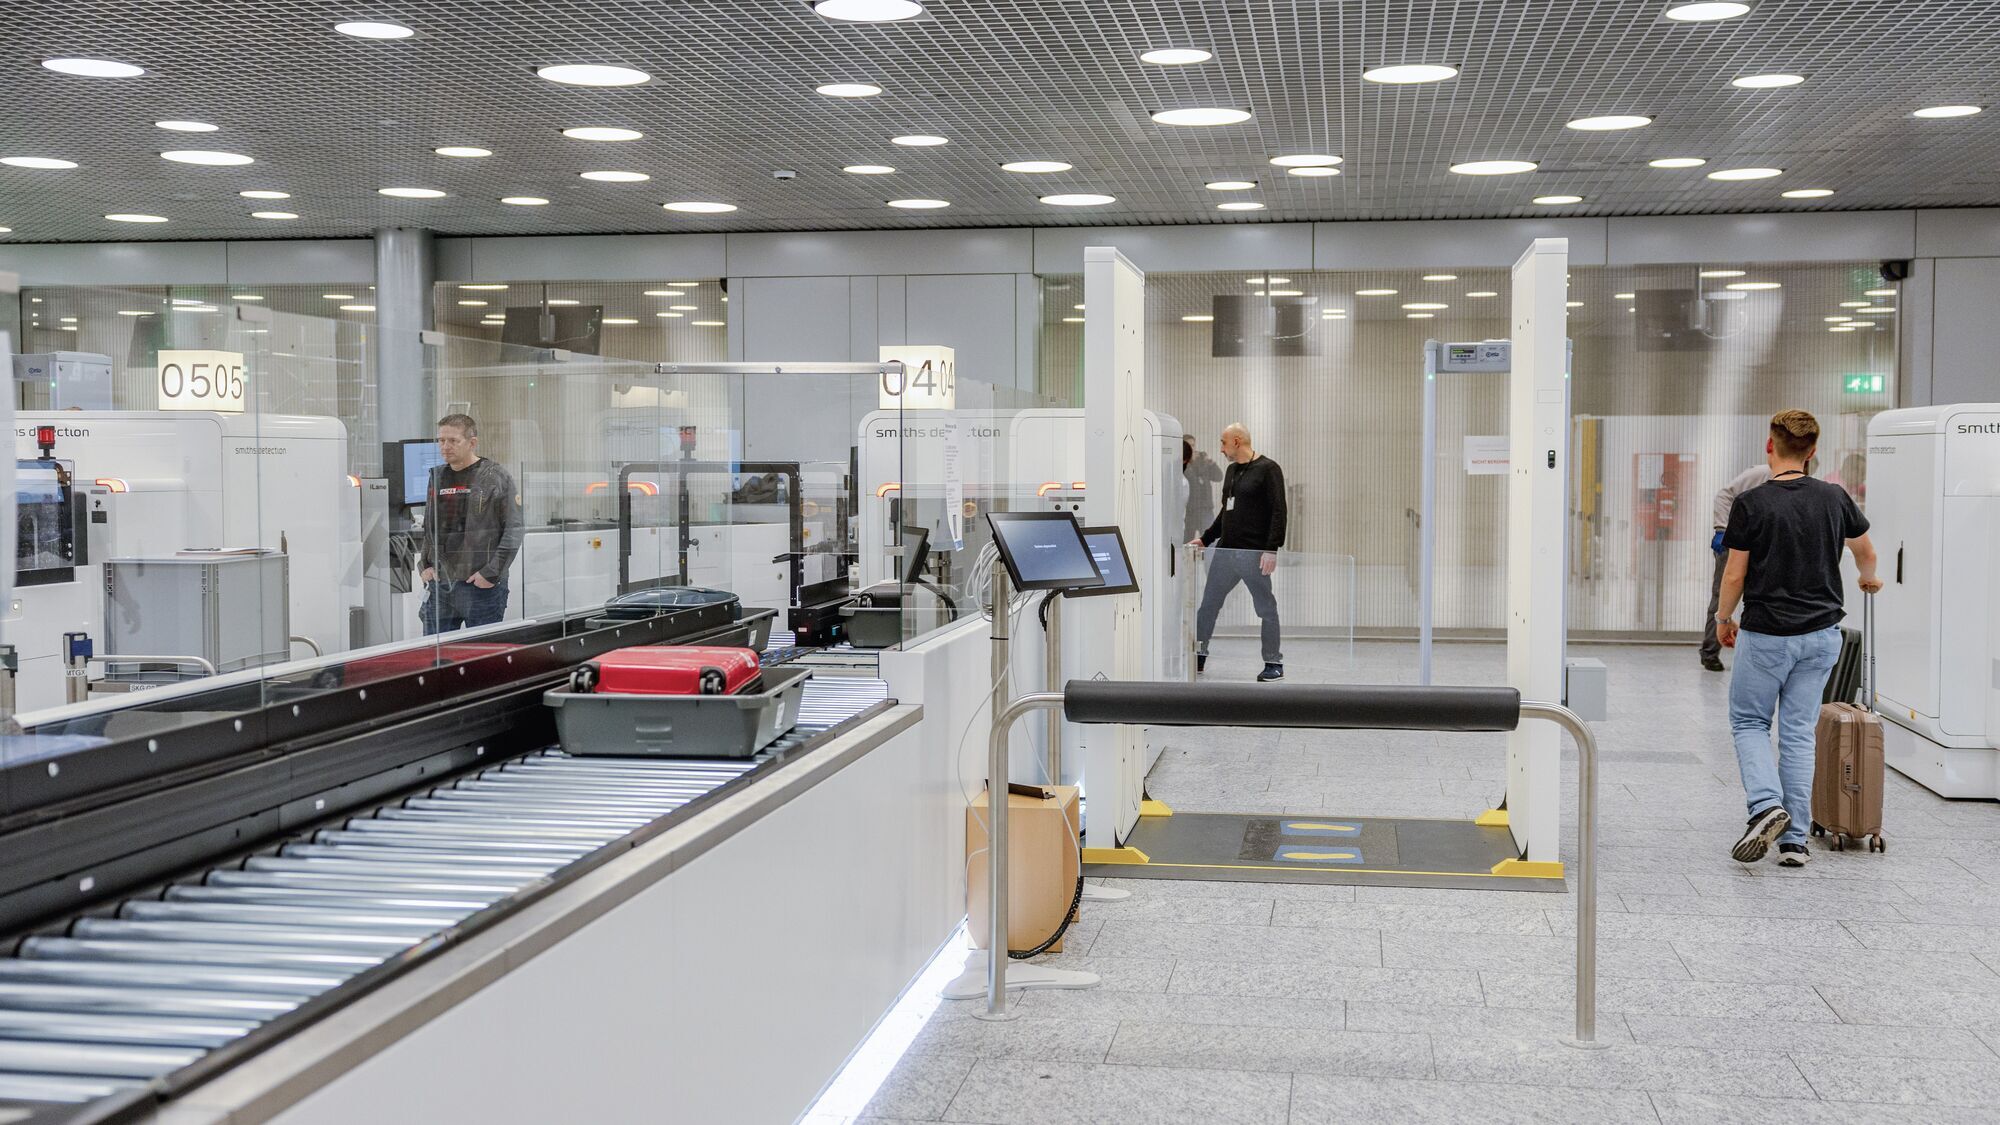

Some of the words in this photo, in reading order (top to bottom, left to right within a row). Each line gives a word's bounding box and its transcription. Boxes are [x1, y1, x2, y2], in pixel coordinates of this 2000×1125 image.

[161, 363, 211, 398] 05
[215, 364, 242, 399] 05
[883, 359, 937, 396] 04
[29, 427, 91, 437] dction
